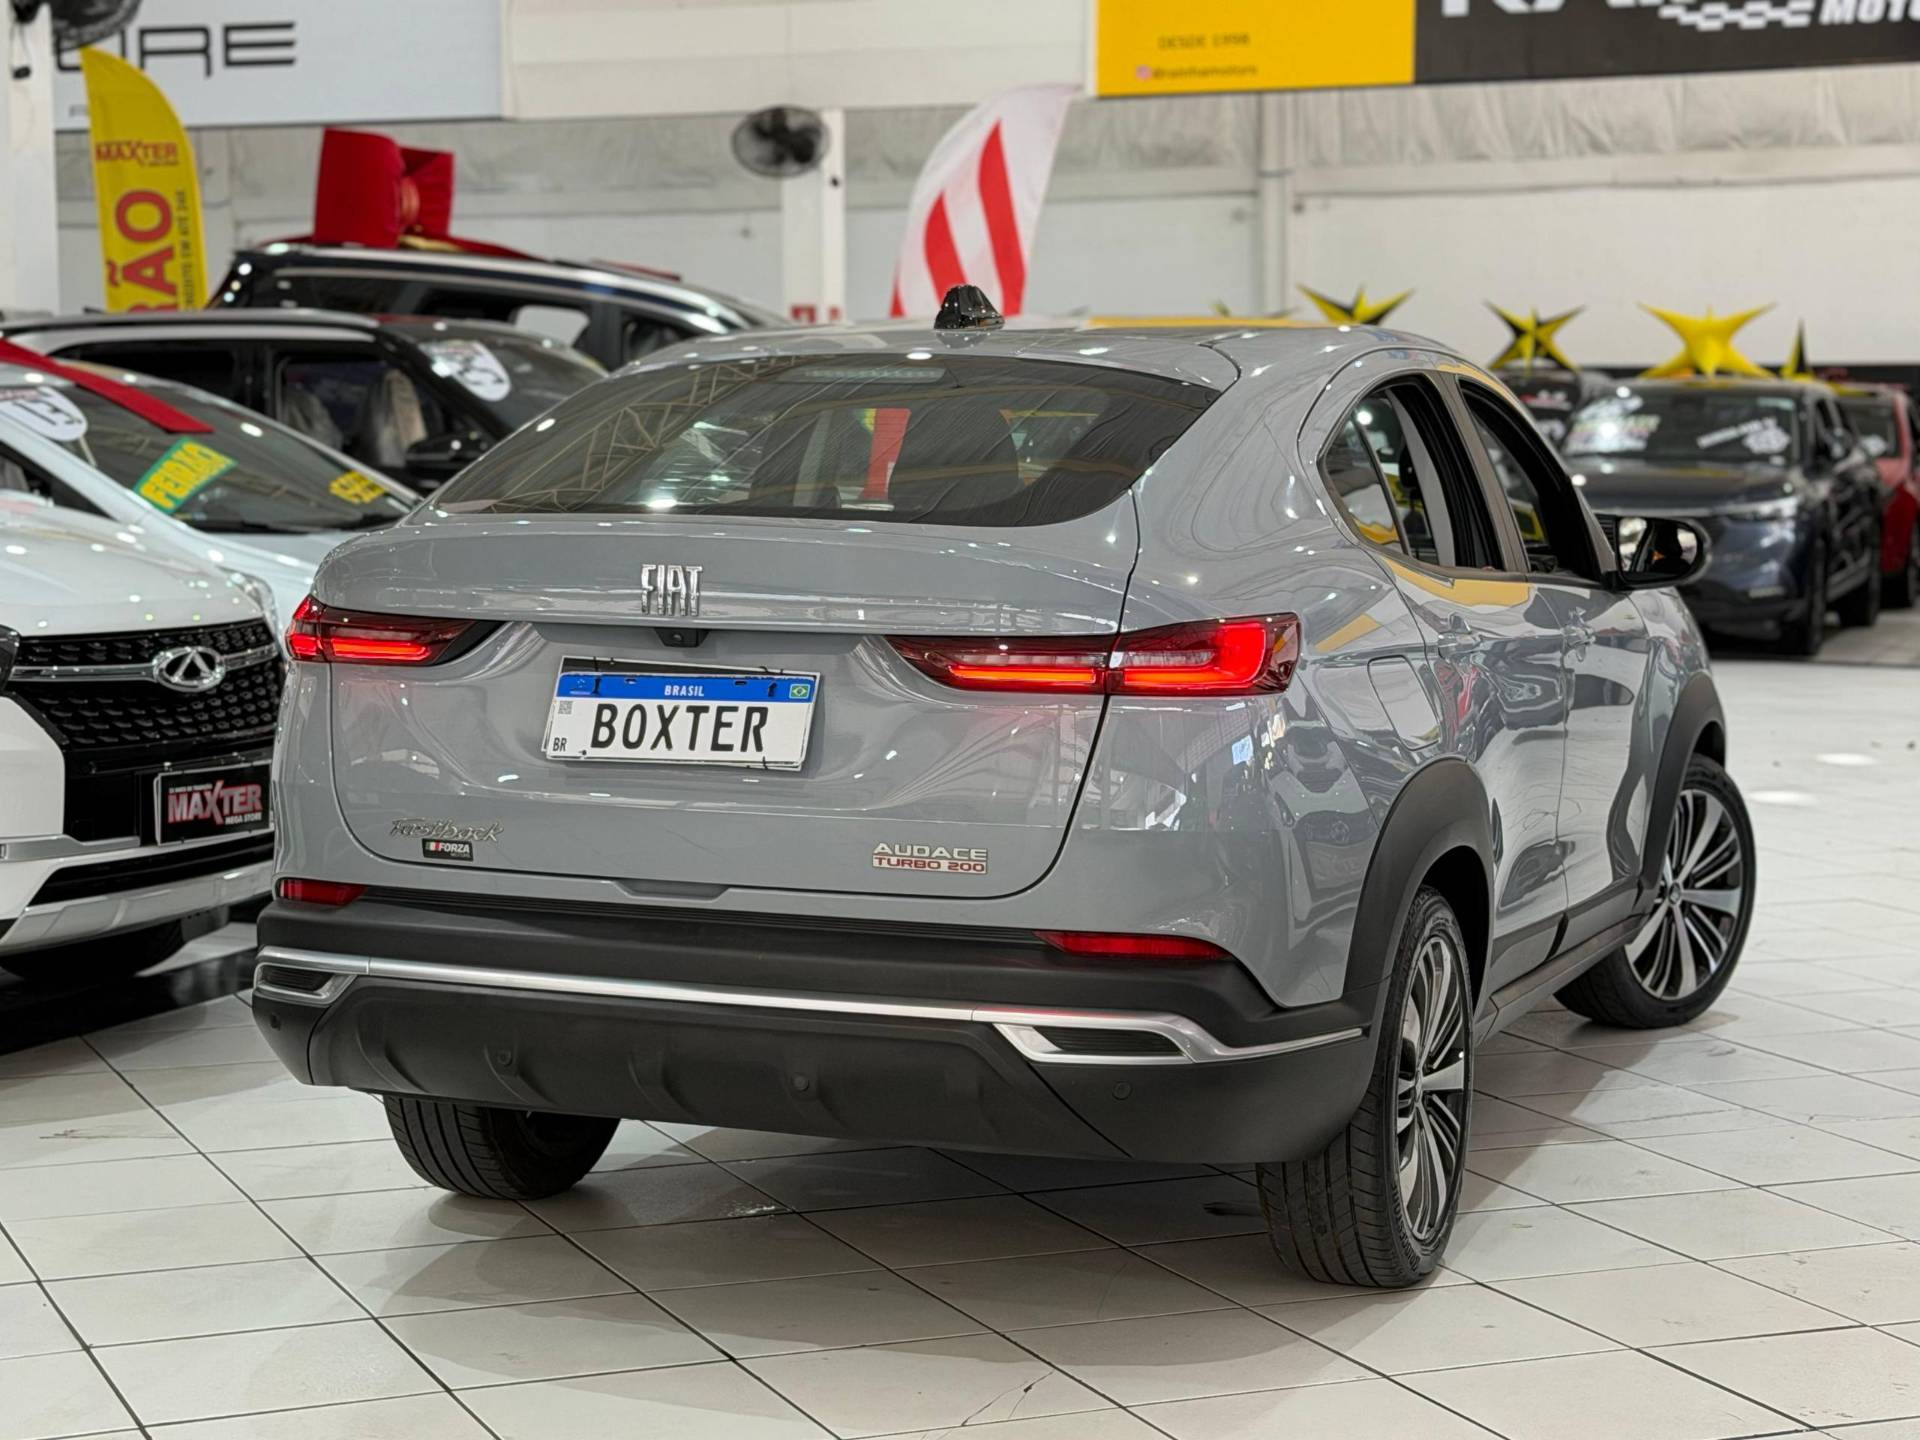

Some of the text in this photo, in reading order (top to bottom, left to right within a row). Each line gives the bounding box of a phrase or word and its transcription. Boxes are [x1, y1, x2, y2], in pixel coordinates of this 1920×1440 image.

[1157, 33, 1207, 50] DESDE
[95, 140, 178, 166] MAXTER
[107, 189, 178, 312] ÃO
[641, 563, 703, 617] FIAT
[664, 684, 705, 698] BRASIL
[590, 703, 769, 753] BOXTER
[552, 737, 568, 752] BR
[167, 780, 263, 825] MAXTER
[438, 842, 471, 853] FORZA
[873, 842, 988, 860] AUDACE
[874, 856, 985, 873] TURBO 200
